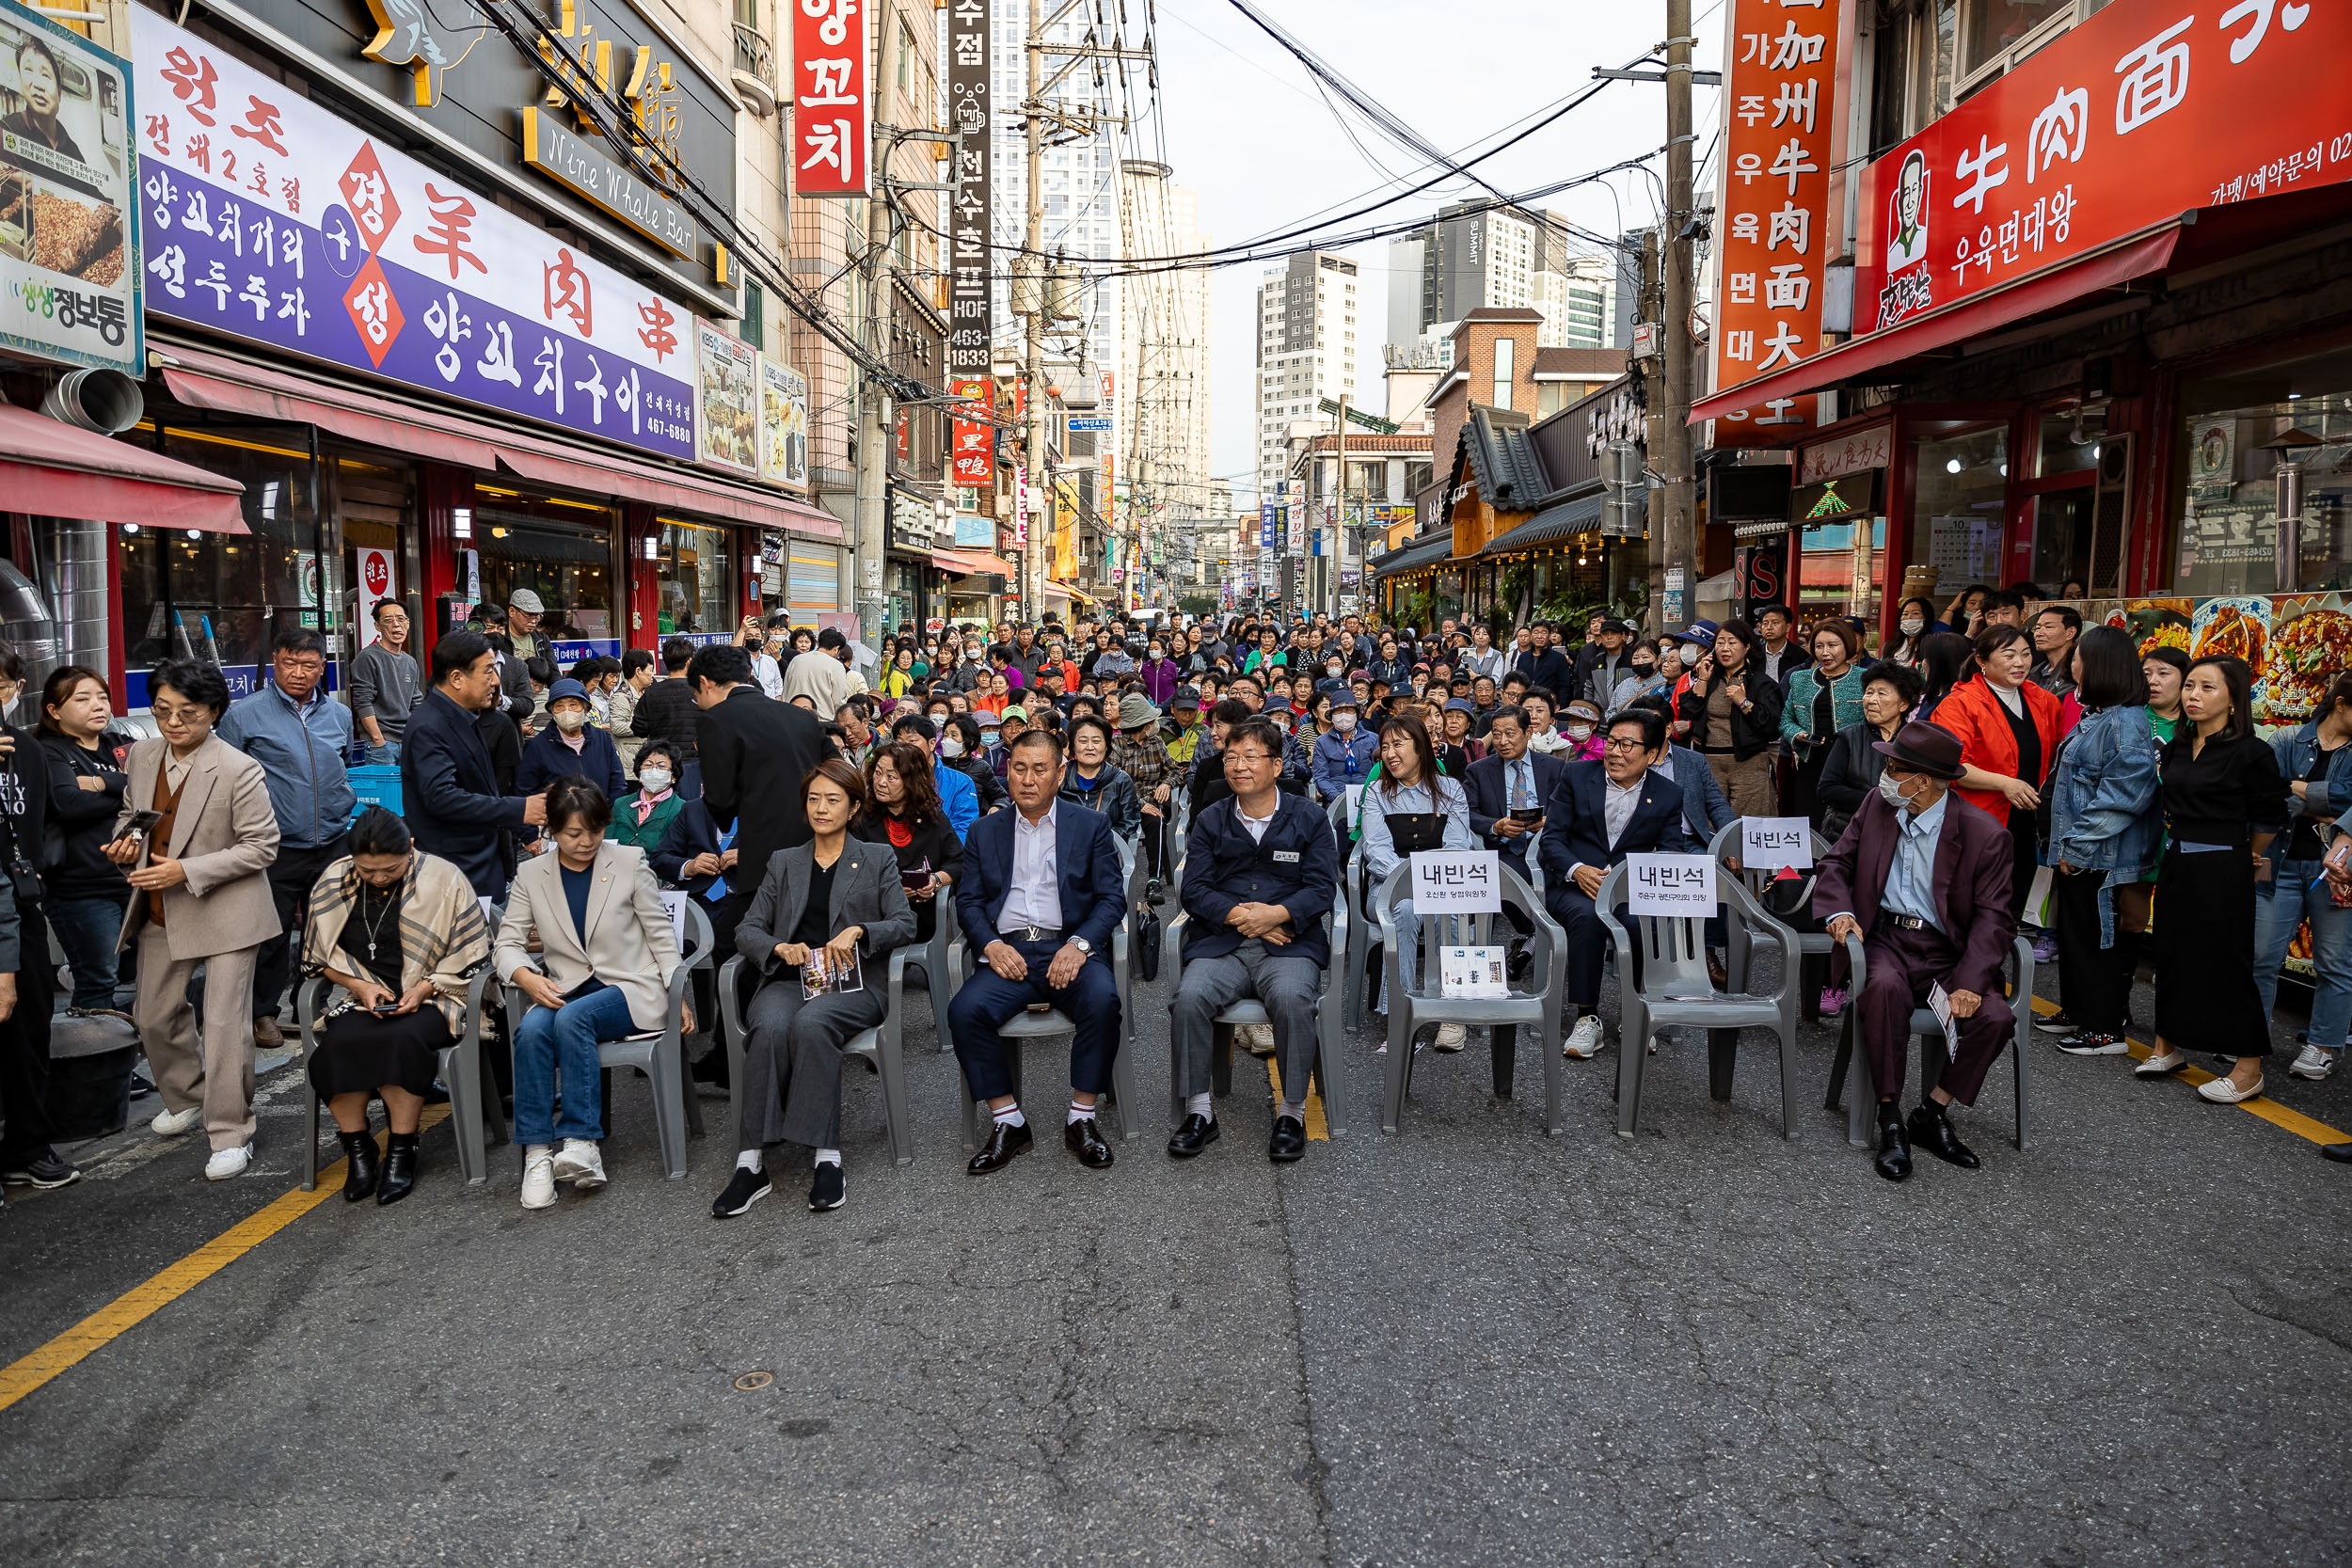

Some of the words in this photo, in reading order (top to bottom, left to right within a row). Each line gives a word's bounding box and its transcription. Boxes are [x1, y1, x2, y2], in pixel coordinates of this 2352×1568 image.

[160, 45, 289, 157] 원조
[548, 128, 599, 190] Nine
[606, 166, 660, 230] Whale
[665, 206, 692, 250] Bar
[145, 169, 303, 279] 양꼬치거리
[1951, 183, 2077, 287] 우육면대왕
[1469, 220, 1479, 265] SUMMIT
[148, 245, 311, 337] 선두주자
[954, 301, 987, 318] HOF
[951, 329, 989, 346] 463-
[423, 292, 642, 436] 양꼬치구이
[951, 349, 988, 366] 1833
[647, 417, 691, 444] 467-6880
[1953, 520, 1964, 530] 10
[2280, 689, 2306, 703] 소고기
[1750, 831, 1801, 848] 내빈석
[1422, 863, 1488, 885] 내빈석
[1639, 865, 1704, 888] 내빈석
[1450, 890, 1487, 898] 당협위원장
[1658, 893, 1691, 901] 광진구의회
